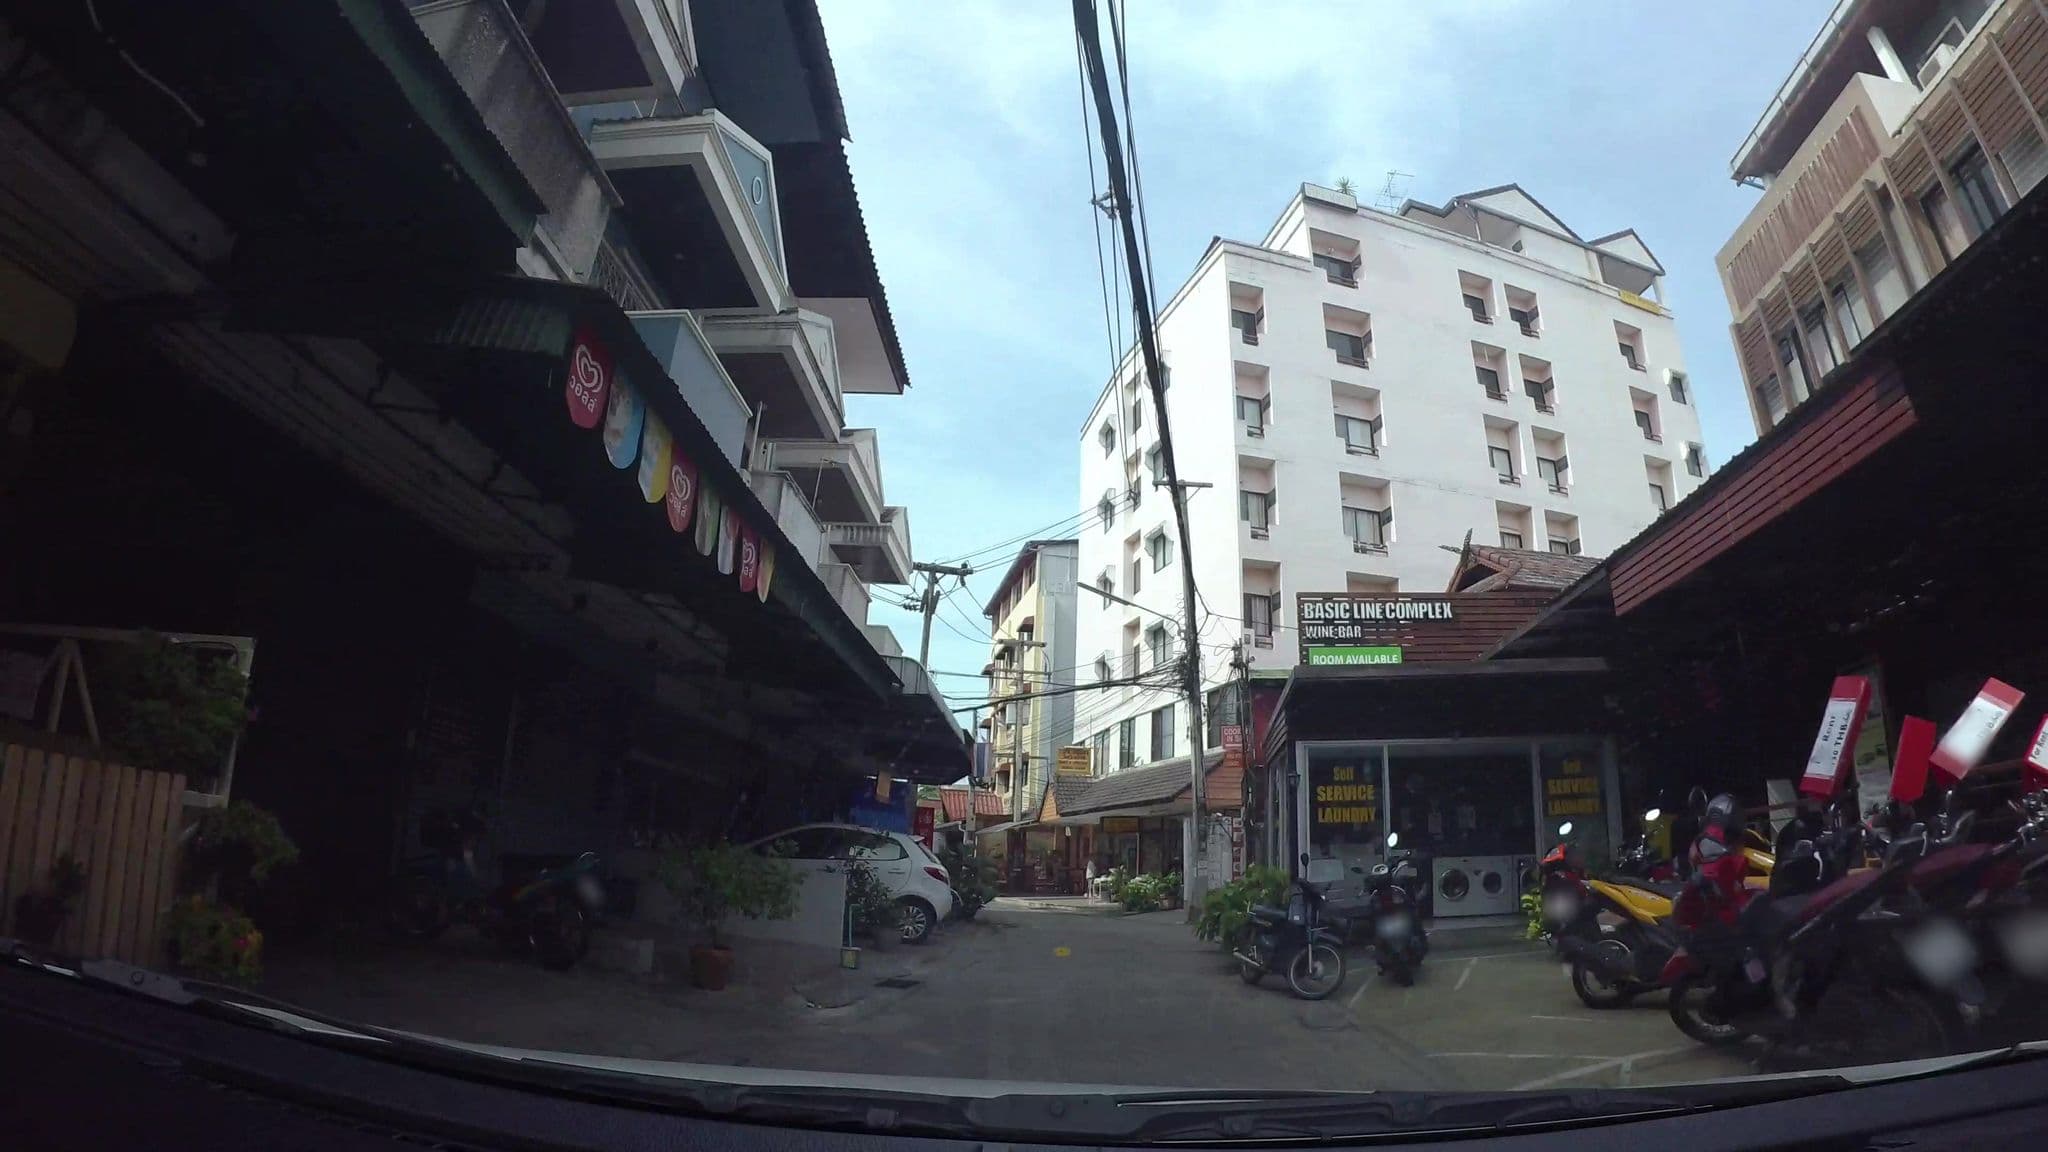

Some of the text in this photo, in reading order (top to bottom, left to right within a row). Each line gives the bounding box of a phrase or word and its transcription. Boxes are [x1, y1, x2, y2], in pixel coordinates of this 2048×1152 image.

[569, 375, 597, 412] วอลล์
[1303, 601, 1453, 619] BASIC LINE COMPLEX
[1305, 625, 1362, 639] WINE BAR
[1312, 653, 1399, 665] ROOM AVAILABLE
[1316, 784, 1376, 802] SERVICE
[1317, 806, 1377, 824] LAUNDRY
